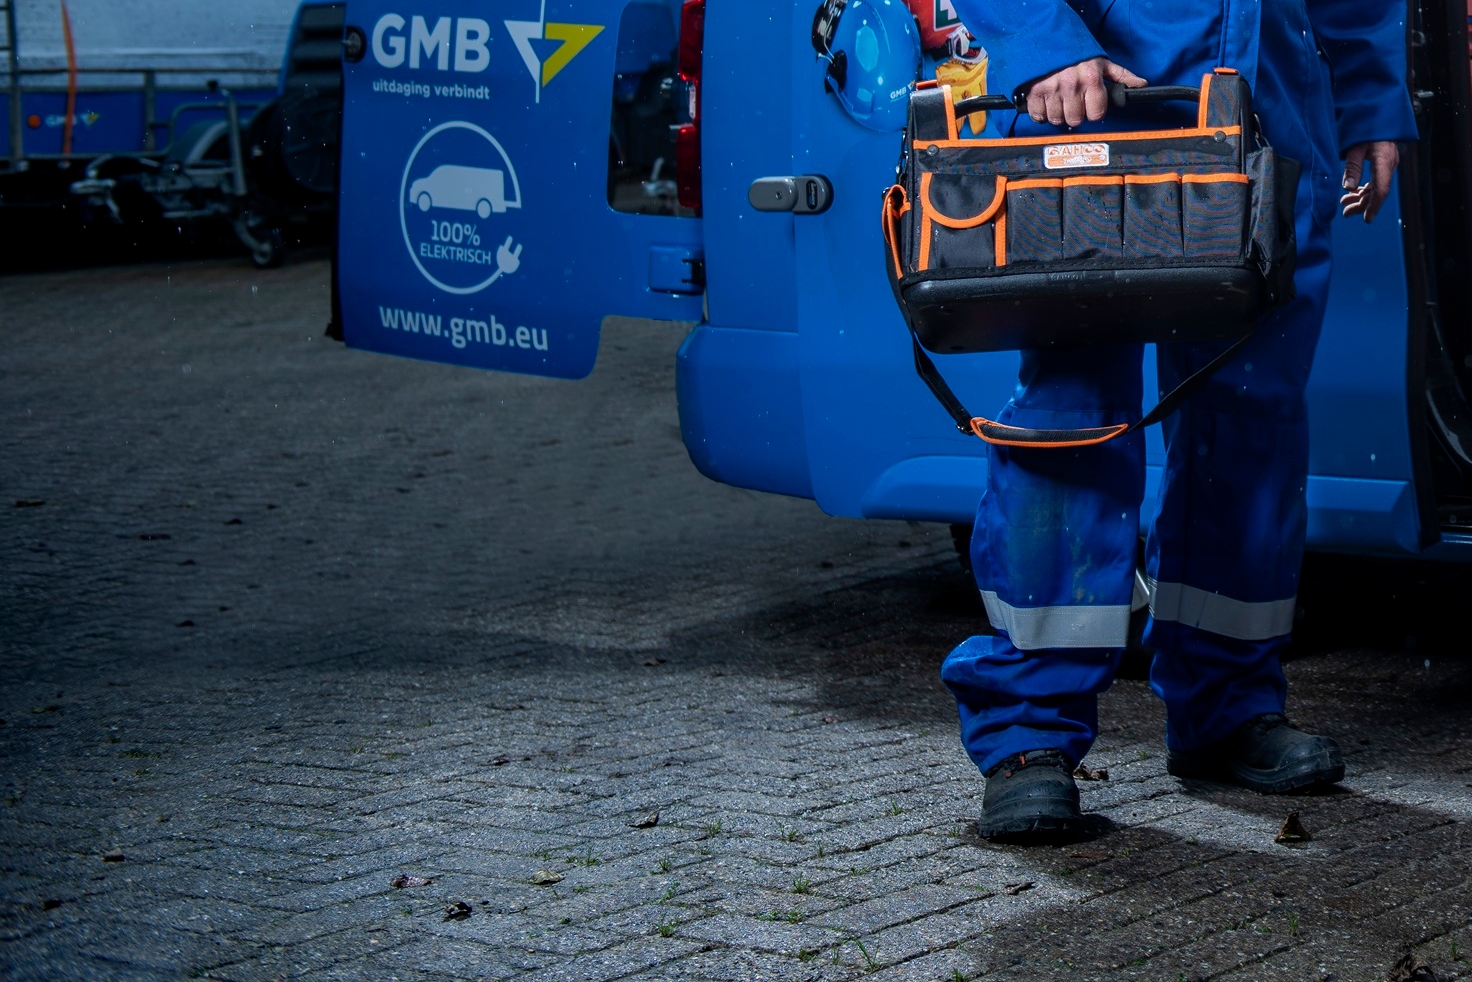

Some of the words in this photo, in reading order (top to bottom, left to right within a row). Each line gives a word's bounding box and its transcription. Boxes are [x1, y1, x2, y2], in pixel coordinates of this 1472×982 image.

[372, 13, 490, 73] GMB
[373, 79, 430, 98] uitdaging
[434, 83, 490, 100] verbindt
[890, 86, 906, 99] GMB
[1047, 144, 1106, 155] BAHCO
[431, 220, 481, 246] 100%
[420, 243, 491, 265] ELEKTRISCH
[380, 305, 548, 351] www.gmb.eu
